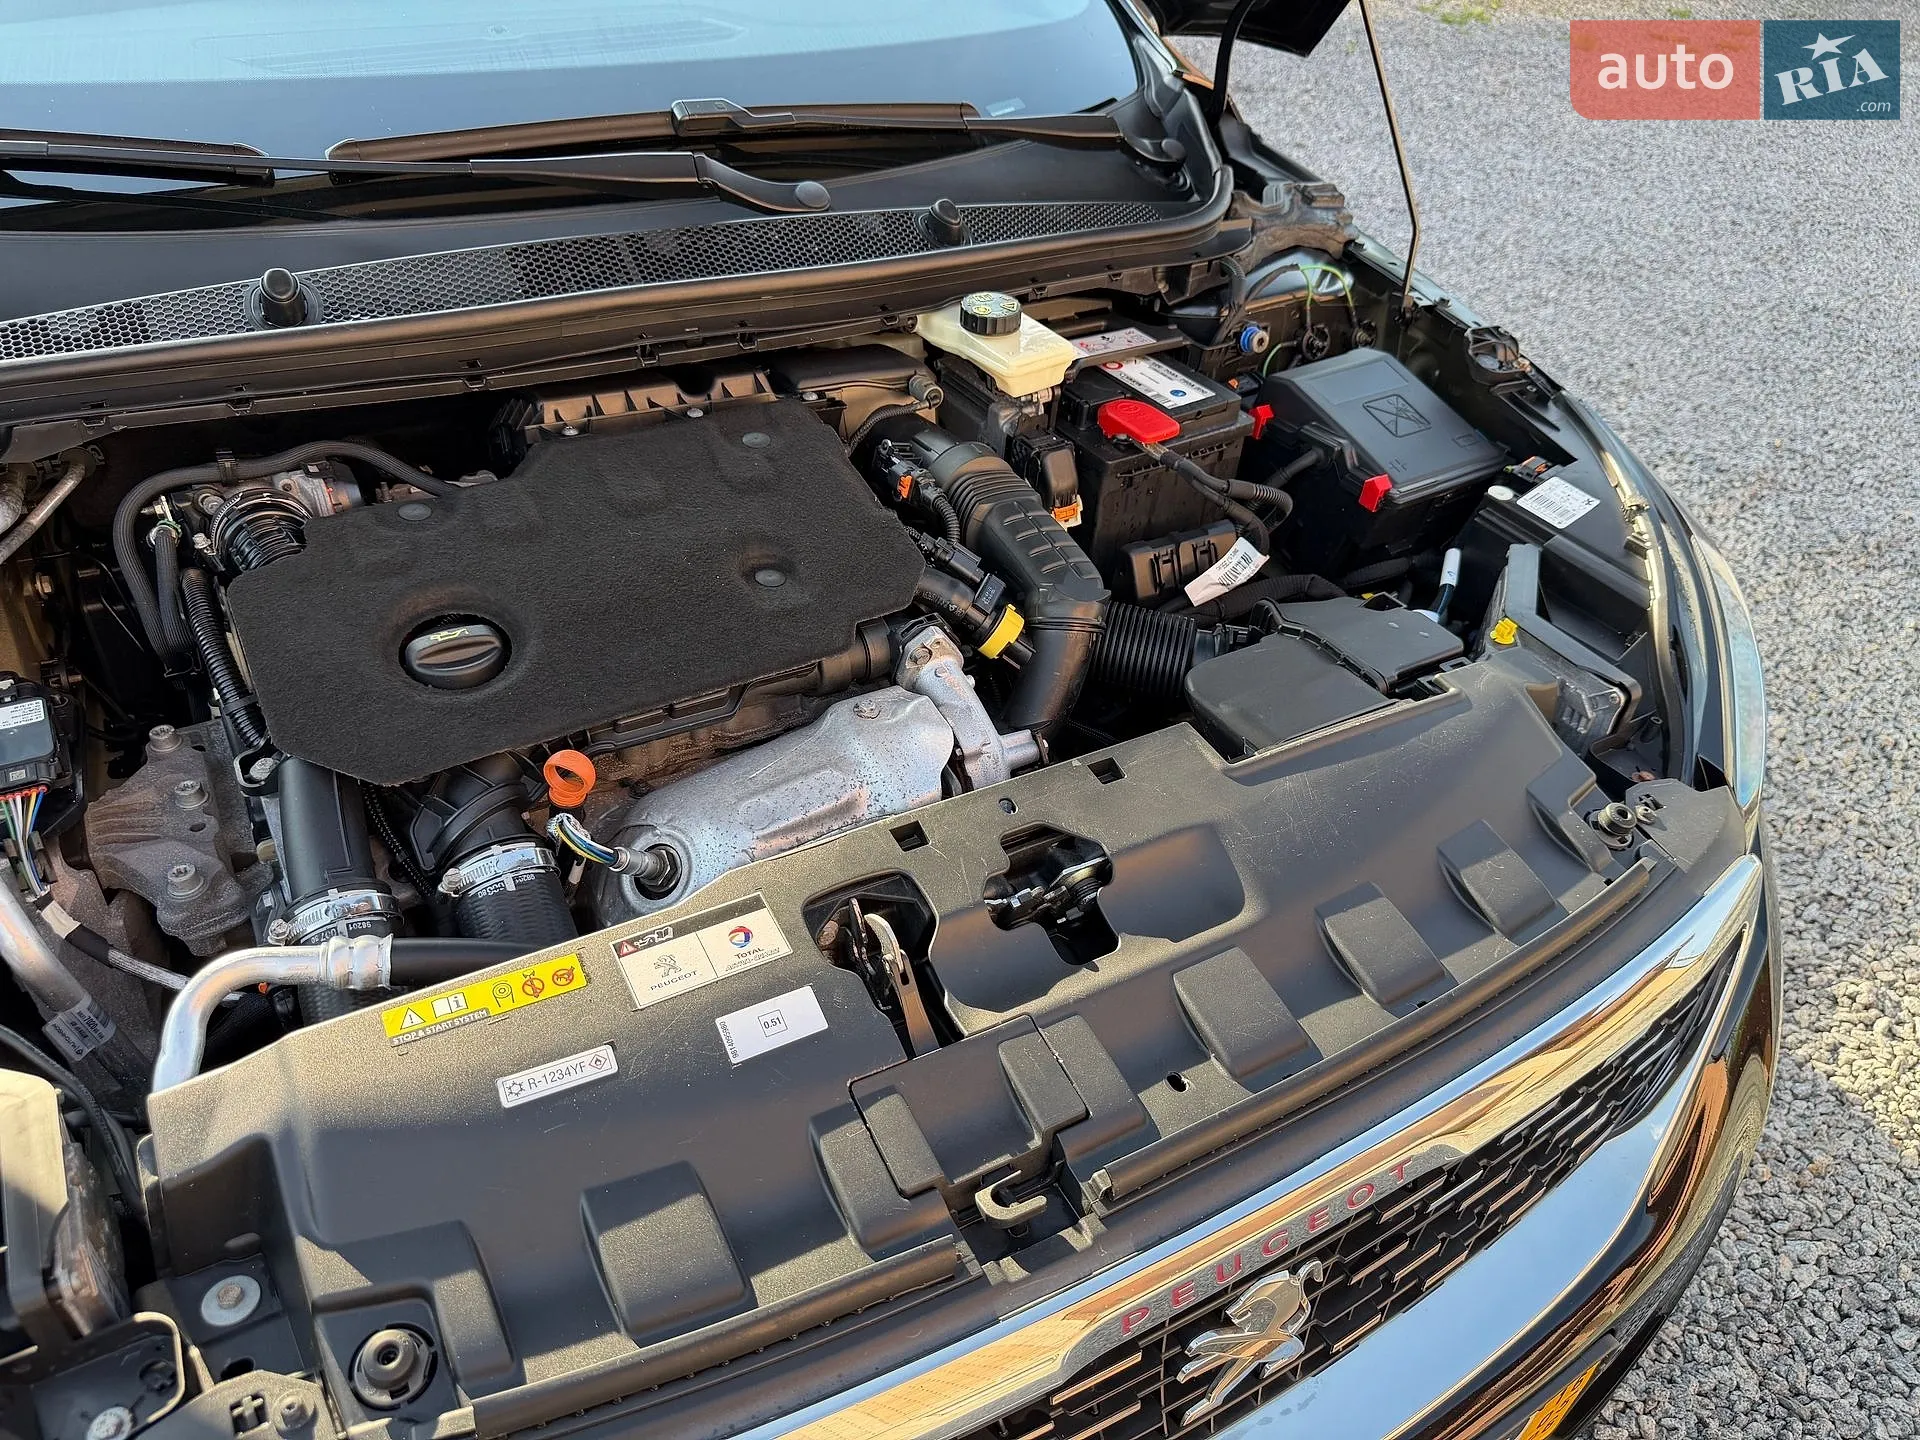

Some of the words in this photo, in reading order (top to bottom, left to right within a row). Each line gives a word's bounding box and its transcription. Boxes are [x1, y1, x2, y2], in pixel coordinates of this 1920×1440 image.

[348, 921, 372, 930] 98201
[734, 947, 765, 959] TOTAL
[650, 971, 698, 991] PEUGEOT
[392, 1032, 419, 1045] STOP
[425, 1021, 453, 1033] START
[454, 1011, 489, 1025] SYSTEM
[763, 1016, 782, 1030] 0.51
[527, 1060, 586, 1090] R-1234YF
[1120, 1157, 1423, 1336] PEUGEOT
